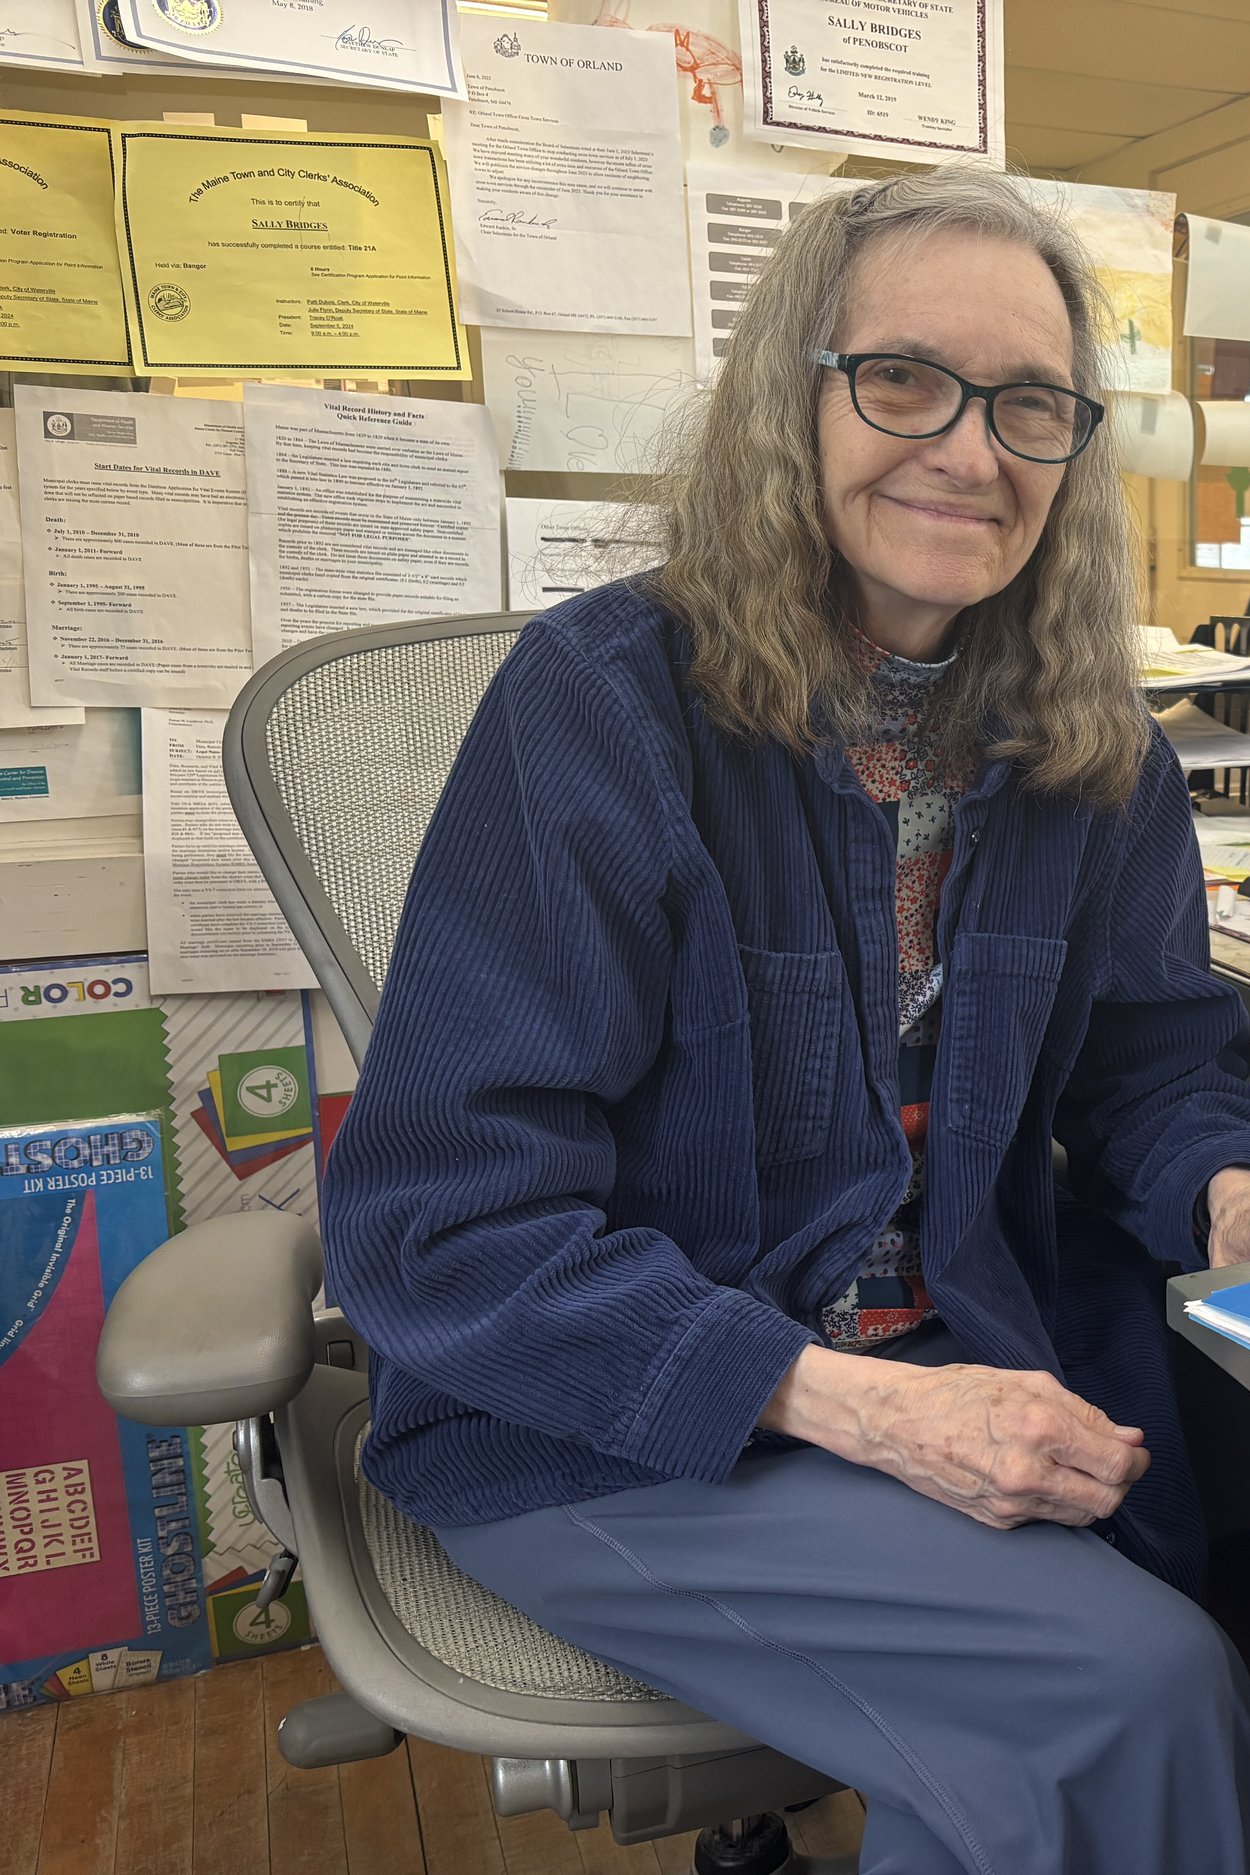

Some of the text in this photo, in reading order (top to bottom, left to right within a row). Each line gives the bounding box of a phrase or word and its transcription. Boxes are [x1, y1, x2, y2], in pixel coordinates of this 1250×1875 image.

[271, 0, 287, 9] May
[863, 2, 891, 13] MOTOR
[892, 8, 929, 19] VEHICLES
[930, 3, 954, 13] STATE
[827, 15, 922, 41] SALLY BRIDGES
[843, 36, 909, 53] of PENOBSCOT
[524, 53, 623, 72] TOWN OF ORLAND
[858, 91, 875, 100] March
[918, 115, 939, 124] WENDY
[189, 168, 380, 207] The Maine Town and City Clerks' Association
[251, 198, 266, 206] This
[284, 200, 305, 208] certify
[252, 218, 328, 229] SALLY BRIDGES
[10, 228, 77, 240] Voter Registration
[221, 241, 259, 249] successfully
[324, 403, 425, 419] Vital Record History and Facts
[337, 413, 357, 422] Quick
[358, 415, 391, 425] Reference
[94, 462, 112, 471] Start
[113, 464, 132, 472] Dates
[133, 465, 143, 473] for
[144, 465, 162, 473] Vital
[163, 467, 190, 475] Records
[199, 469, 221, 477] DAVE
[51, 624, 83, 632] Marriage:
[19, 976, 134, 1007] COLOR
[245, 1079, 279, 1103] 4
[275, 1071, 294, 1108] SHEETS
[23, 1166, 154, 1193] 13-PIECE POSTER KIT
[65, 1198, 76, 1214] The
[53, 1216, 71, 1254] Original
[36, 1254, 63, 1288] Invisible
[7, 1319, 24, 1338] Grid
[148, 1434, 201, 1629] GHOSTLINE
[137, 1537, 162, 1635] 13-PIECE POSTER KIT
[100, 1653, 108, 1661] 8
[73, 1666, 81, 1675] 4
